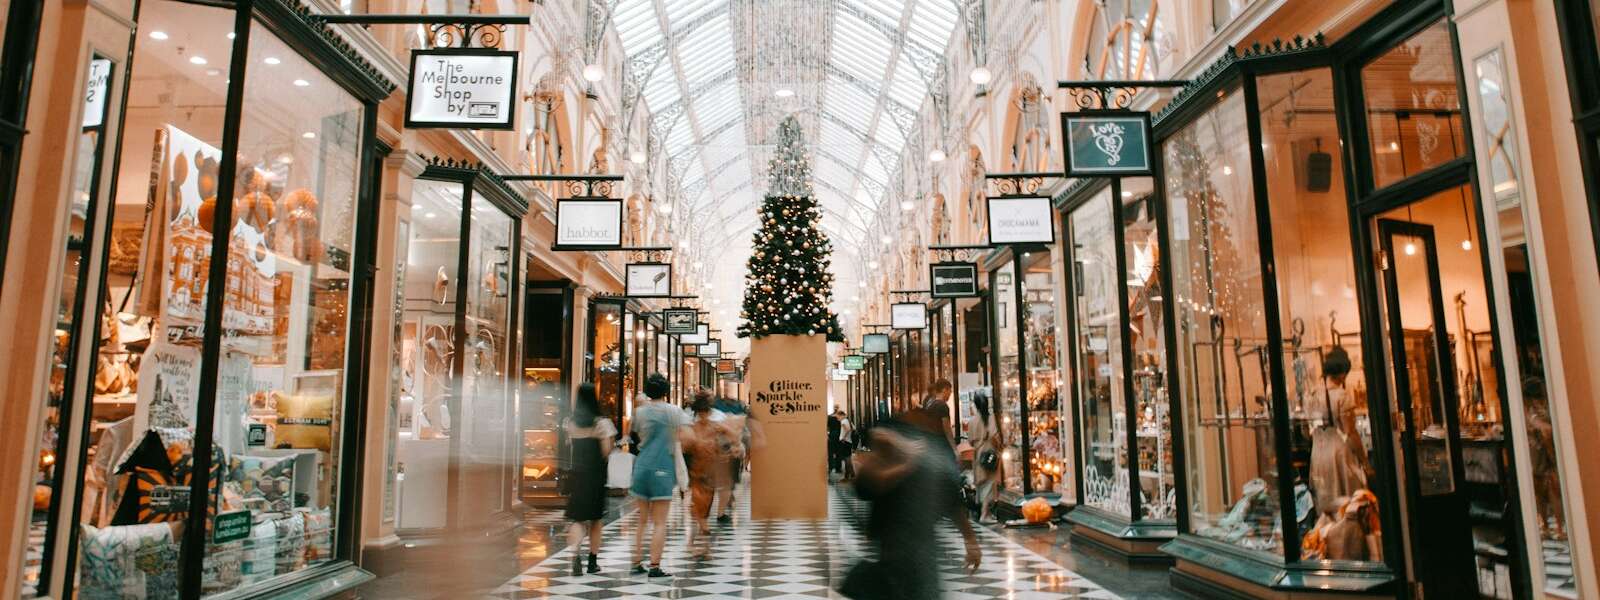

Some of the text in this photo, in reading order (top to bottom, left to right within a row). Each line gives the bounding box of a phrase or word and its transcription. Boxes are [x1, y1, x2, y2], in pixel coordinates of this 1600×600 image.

[437, 60, 463, 73] The
[422, 70, 503, 85] Melbourne
[434, 86, 472, 103] Shop
[448, 103, 465, 116] by
[756, 391, 803, 404] Sparkle
